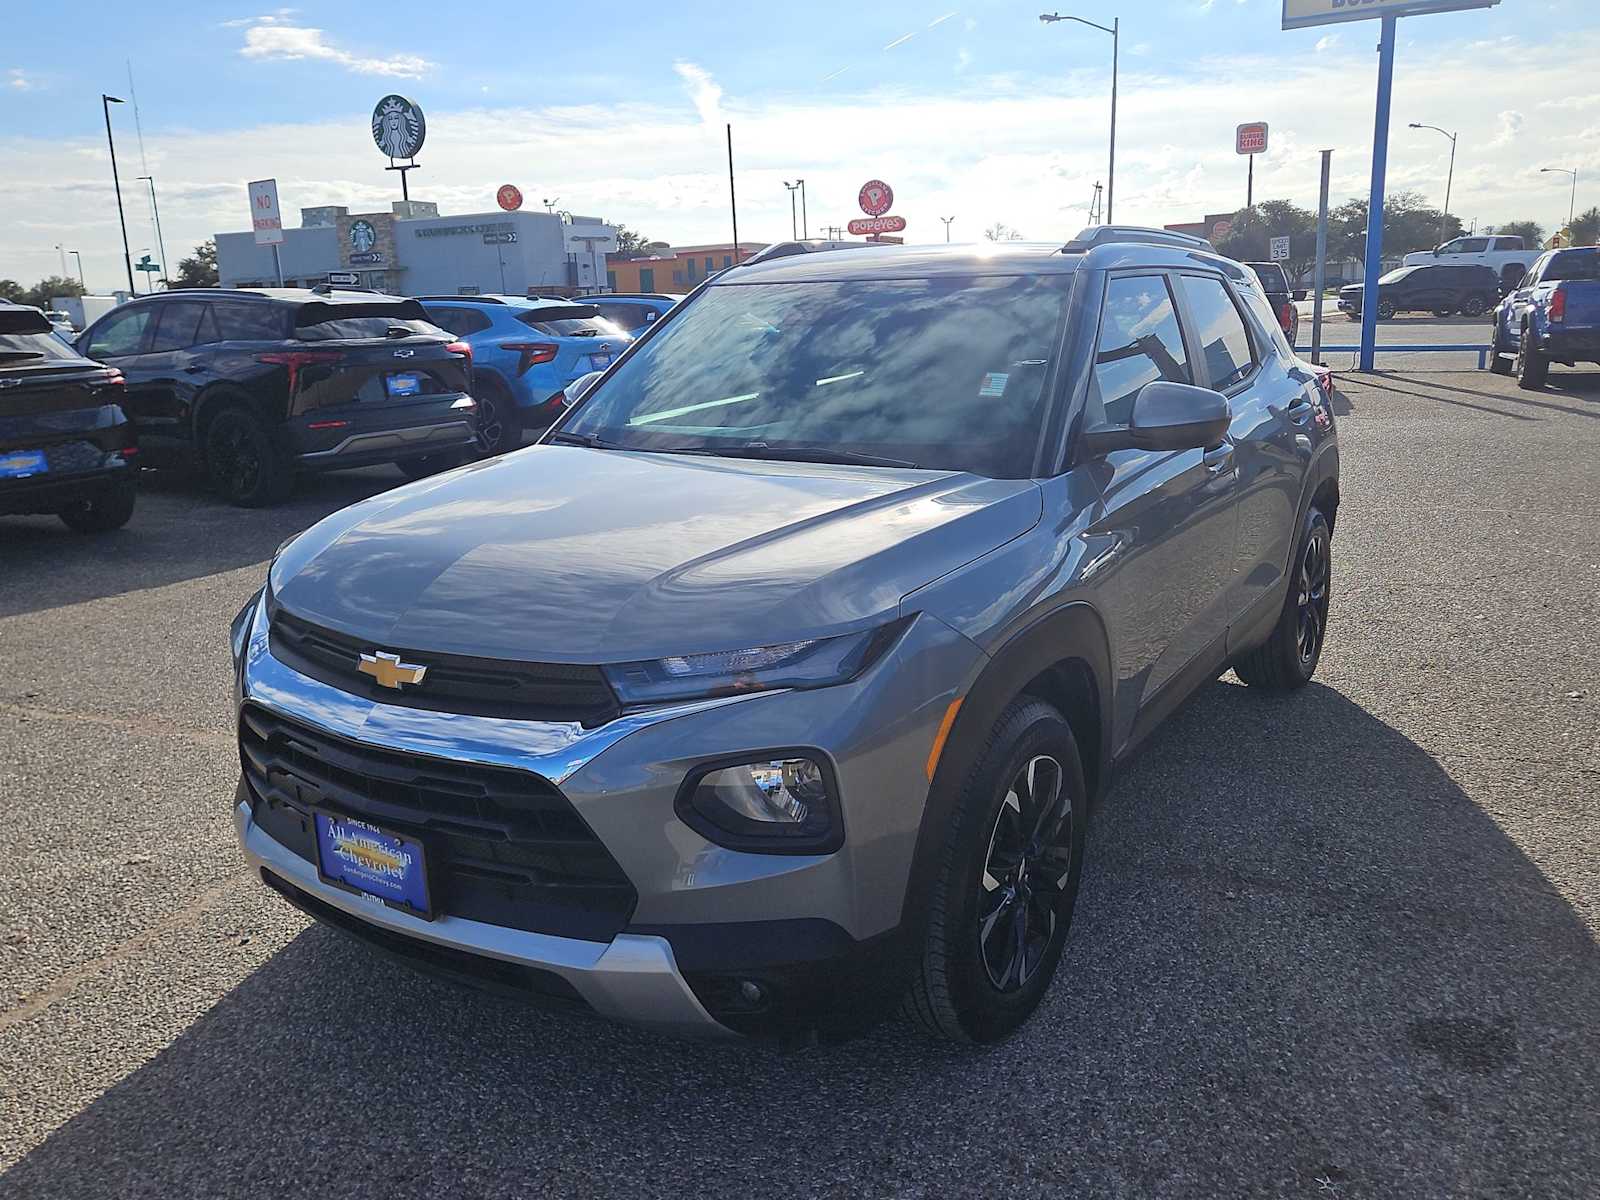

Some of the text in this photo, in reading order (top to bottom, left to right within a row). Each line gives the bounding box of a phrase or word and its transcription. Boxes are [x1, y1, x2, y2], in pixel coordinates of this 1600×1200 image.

[1240, 138, 1264, 148] KING
[256, 194, 271, 208] NO
[1272, 248, 1288, 259] 35
[347, 817, 366, 830] SINCE
[328, 824, 412, 865] All American
[337, 845, 404, 880] Chevrolet
